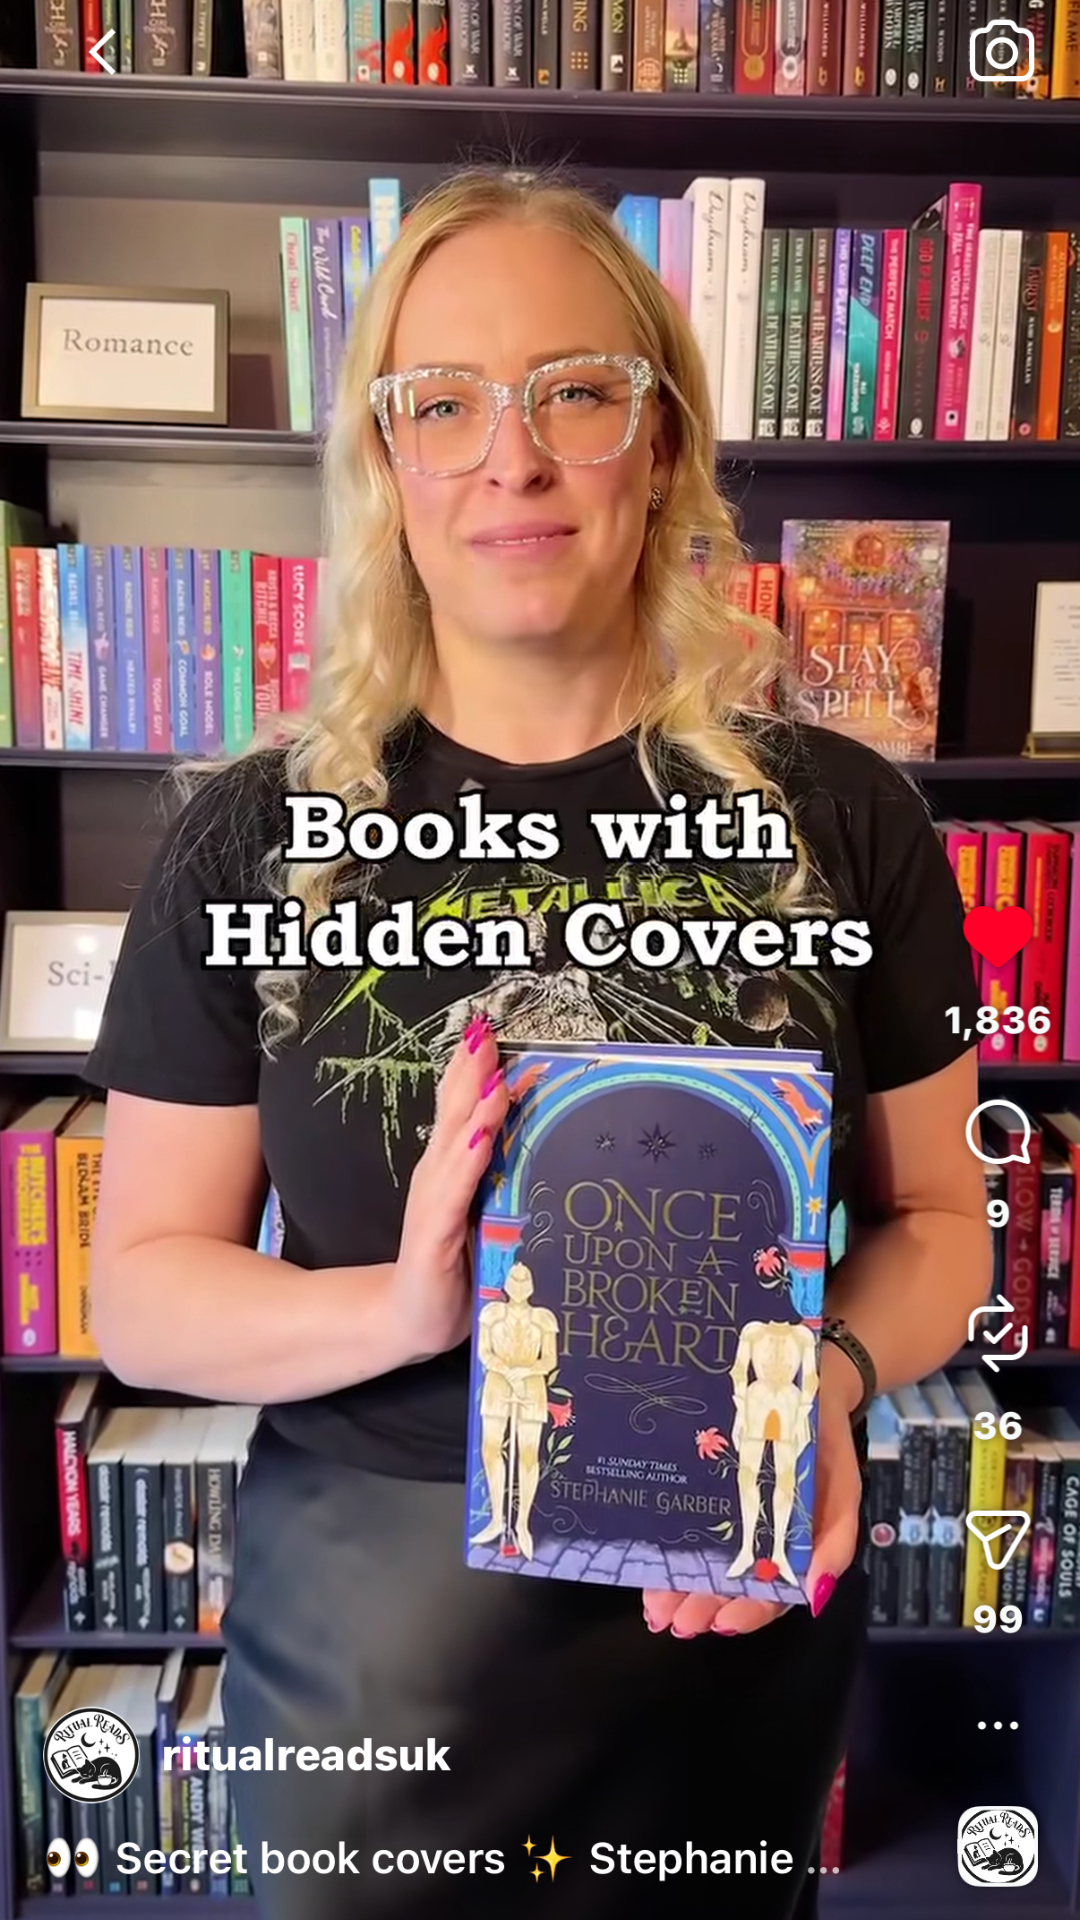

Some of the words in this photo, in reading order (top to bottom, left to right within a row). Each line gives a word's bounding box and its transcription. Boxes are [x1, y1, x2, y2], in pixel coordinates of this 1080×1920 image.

[858, 2, 866, 58] WILLIAMSON
[936, 29, 945, 63] WOODS
[704, 190, 723, 273] Daydream
[739, 191, 757, 273] Daydream
[952, 232, 963, 254] FALL
[312, 245, 330, 282] Wild
[860, 233, 875, 275] DEEP
[859, 276, 873, 307] END
[887, 255, 898, 301] PERFECT
[950, 269, 961, 297] YOUR
[1023, 266, 1041, 311] FAIREST
[317, 283, 337, 320] Card
[884, 303, 895, 339] MATCH
[948, 299, 959, 330] ENEMY
[958, 304, 968, 330] URGE
[62, 327, 194, 358] Romance
[764, 315, 778, 383] DEATHLESS
[787, 315, 802, 382] DEATHLESS
[811, 316, 825, 384] HEARTLESS
[761, 384, 775, 414] ONE
[785, 383, 798, 413] ONE
[809, 385, 822, 413] ONE
[95, 575, 104, 608] RACHEL
[124, 581, 133, 615] RACHEL
[293, 565, 304, 601] LUCY
[256, 581, 268, 626] RITCHIE
[293, 602, 304, 646] SCORE
[68, 650, 82, 681] TIME
[98, 666, 107, 693] GAME
[126, 660, 136, 695] HEATED
[802, 639, 921, 687] STAY
[152, 678, 163, 713] TOUGH
[177, 659, 187, 708] COMMON
[203, 671, 212, 698] ROLE
[69, 689, 83, 726] SHINE
[99, 695, 108, 738] CHANGER
[127, 698, 136, 735] RIVALRY
[153, 715, 162, 736] GUY
[179, 710, 188, 737] GOAL
[204, 700, 214, 736] MODEL
[792, 688, 929, 731] SPELL
[77, 1152, 89, 1206] BEDLAM
[92, 1152, 102, 1174] THE
[564, 1179, 742, 1244] ONCE
[1014, 1164, 1034, 1232] SLOW
[1049, 1188, 1063, 1224] TERMS
[79, 1209, 91, 1249] BRIDE
[564, 1231, 677, 1275] UPON
[1046, 1237, 1061, 1279] SERVICE
[560, 1269, 741, 1325] BROKEN
[1012, 1258, 1033, 1324] GODS
[559, 1313, 742, 1374] HEART
[63, 1431, 79, 1493] HALCYON
[586, 1465, 643, 1481] BESTSELLING
[645, 1470, 688, 1485] AUTHOR
[607, 1457, 646, 1471] SUNDAY
[647, 1460, 677, 1473] TIMES
[66, 1494, 81, 1537] YEARS
[208, 1468, 222, 1531] HOWLING
[550, 1478, 648, 1509] STEPHANIE
[656, 1492, 732, 1517] GARBER
[1064, 1476, 1079, 1518] CAGE
[98, 1505, 112, 1552] reynolds
[134, 1519, 148, 1567] reynolds
[1062, 1523, 1076, 1544] OF
[1058, 1549, 1074, 1598] SOULS
[190, 1776, 203, 1825] ANDY
